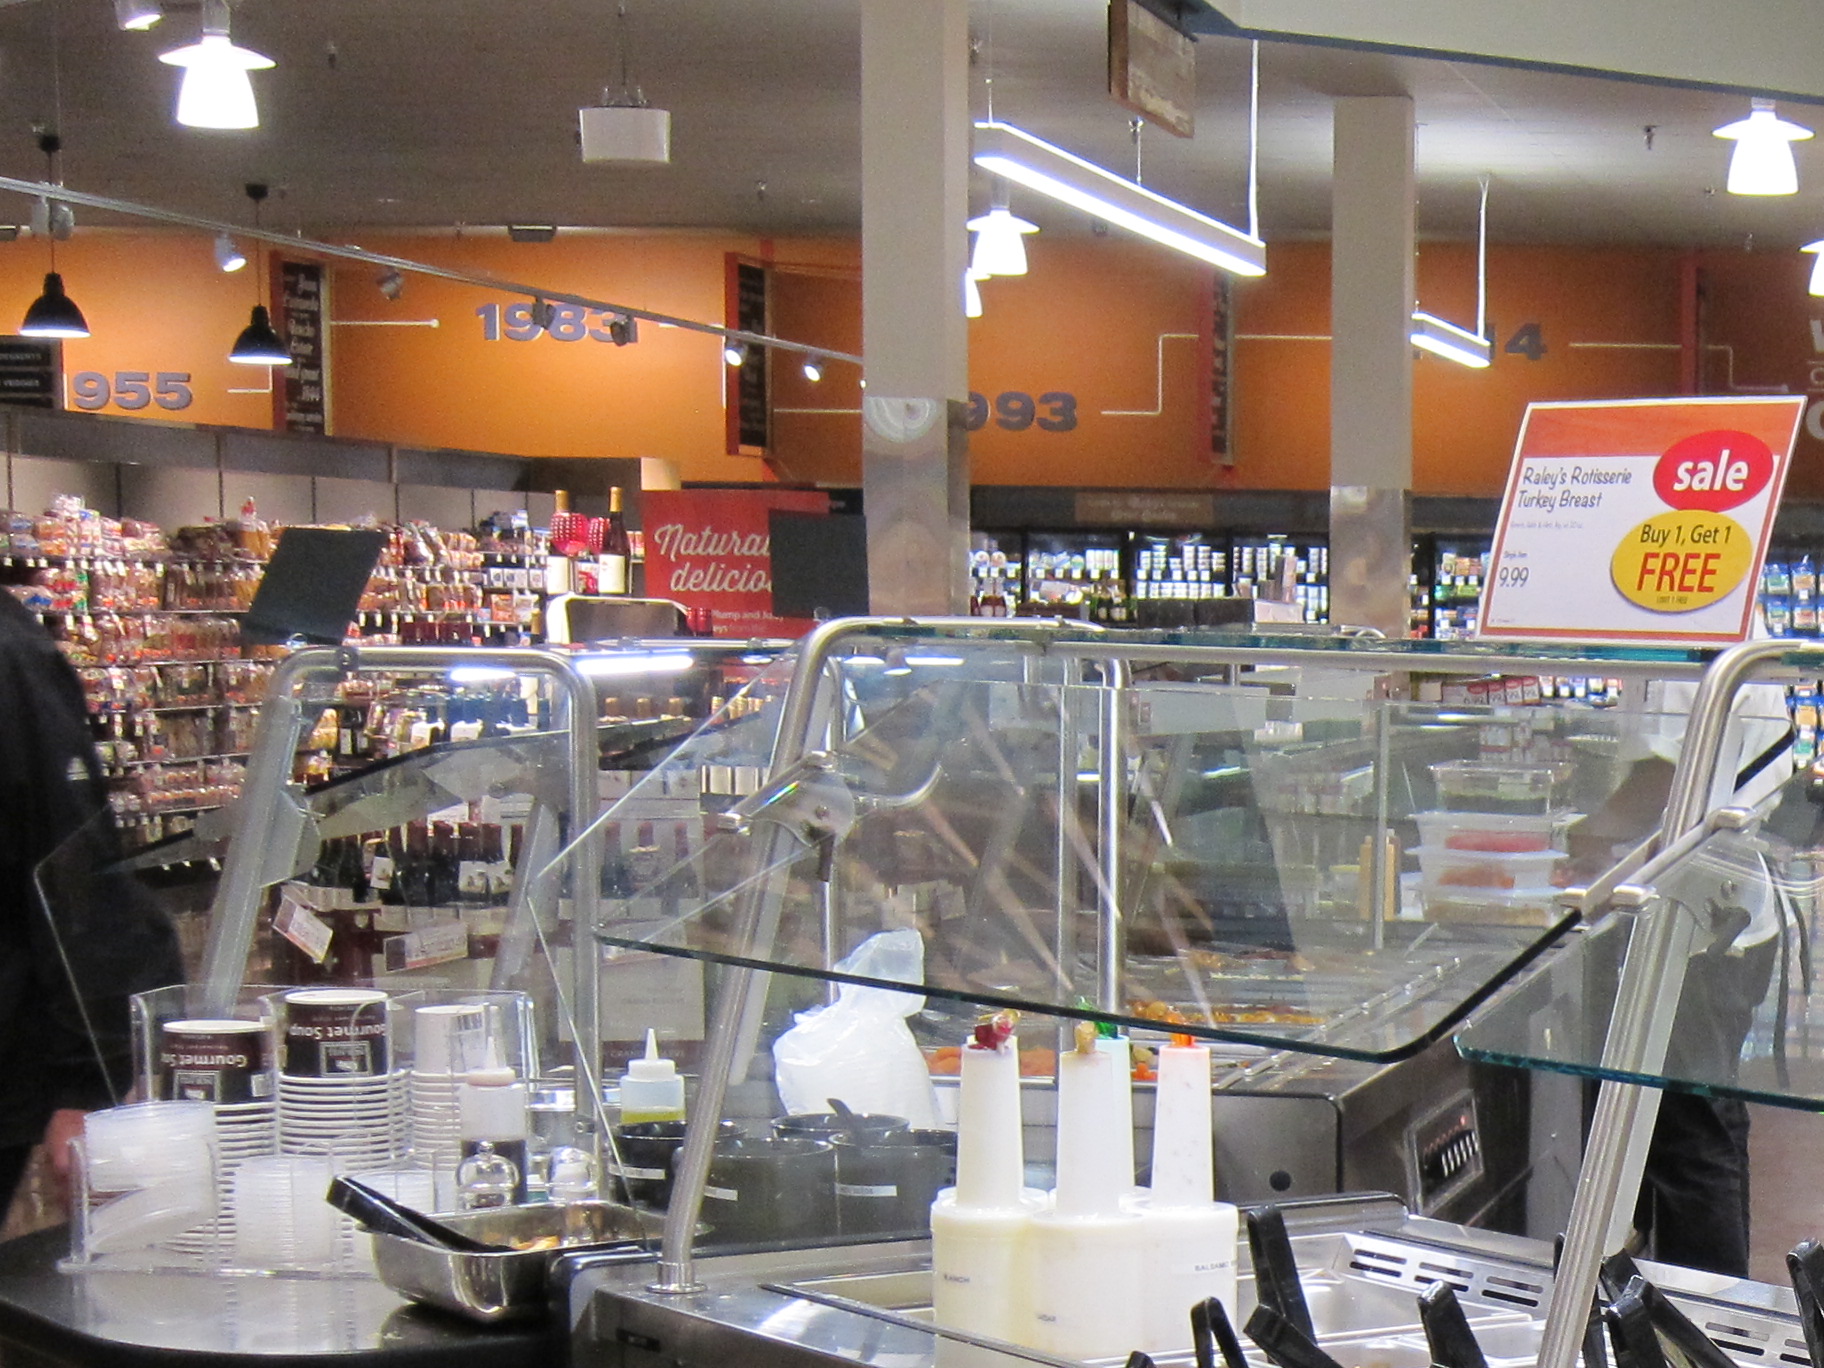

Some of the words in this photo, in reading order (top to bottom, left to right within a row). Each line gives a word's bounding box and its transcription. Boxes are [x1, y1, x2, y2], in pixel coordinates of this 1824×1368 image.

[1522, 466, 1567, 490] Raley's
[1570, 466, 1633, 486] Rotisserie
[1672, 448, 1750, 492] sale
[1518, 489, 1558, 513] Turkey
[1559, 489, 1603, 508] Breast
[654, 523, 771, 563] Natura
[1640, 524, 1671, 547] Buy
[1675, 525, 1687, 546] 1,
[1690, 524, 1720, 545] Get
[1723, 525, 1733, 544] 1
[670, 561, 774, 593] delicio
[1499, 566, 1530, 588] 9.99
[1636, 551, 1722, 593] FREE
